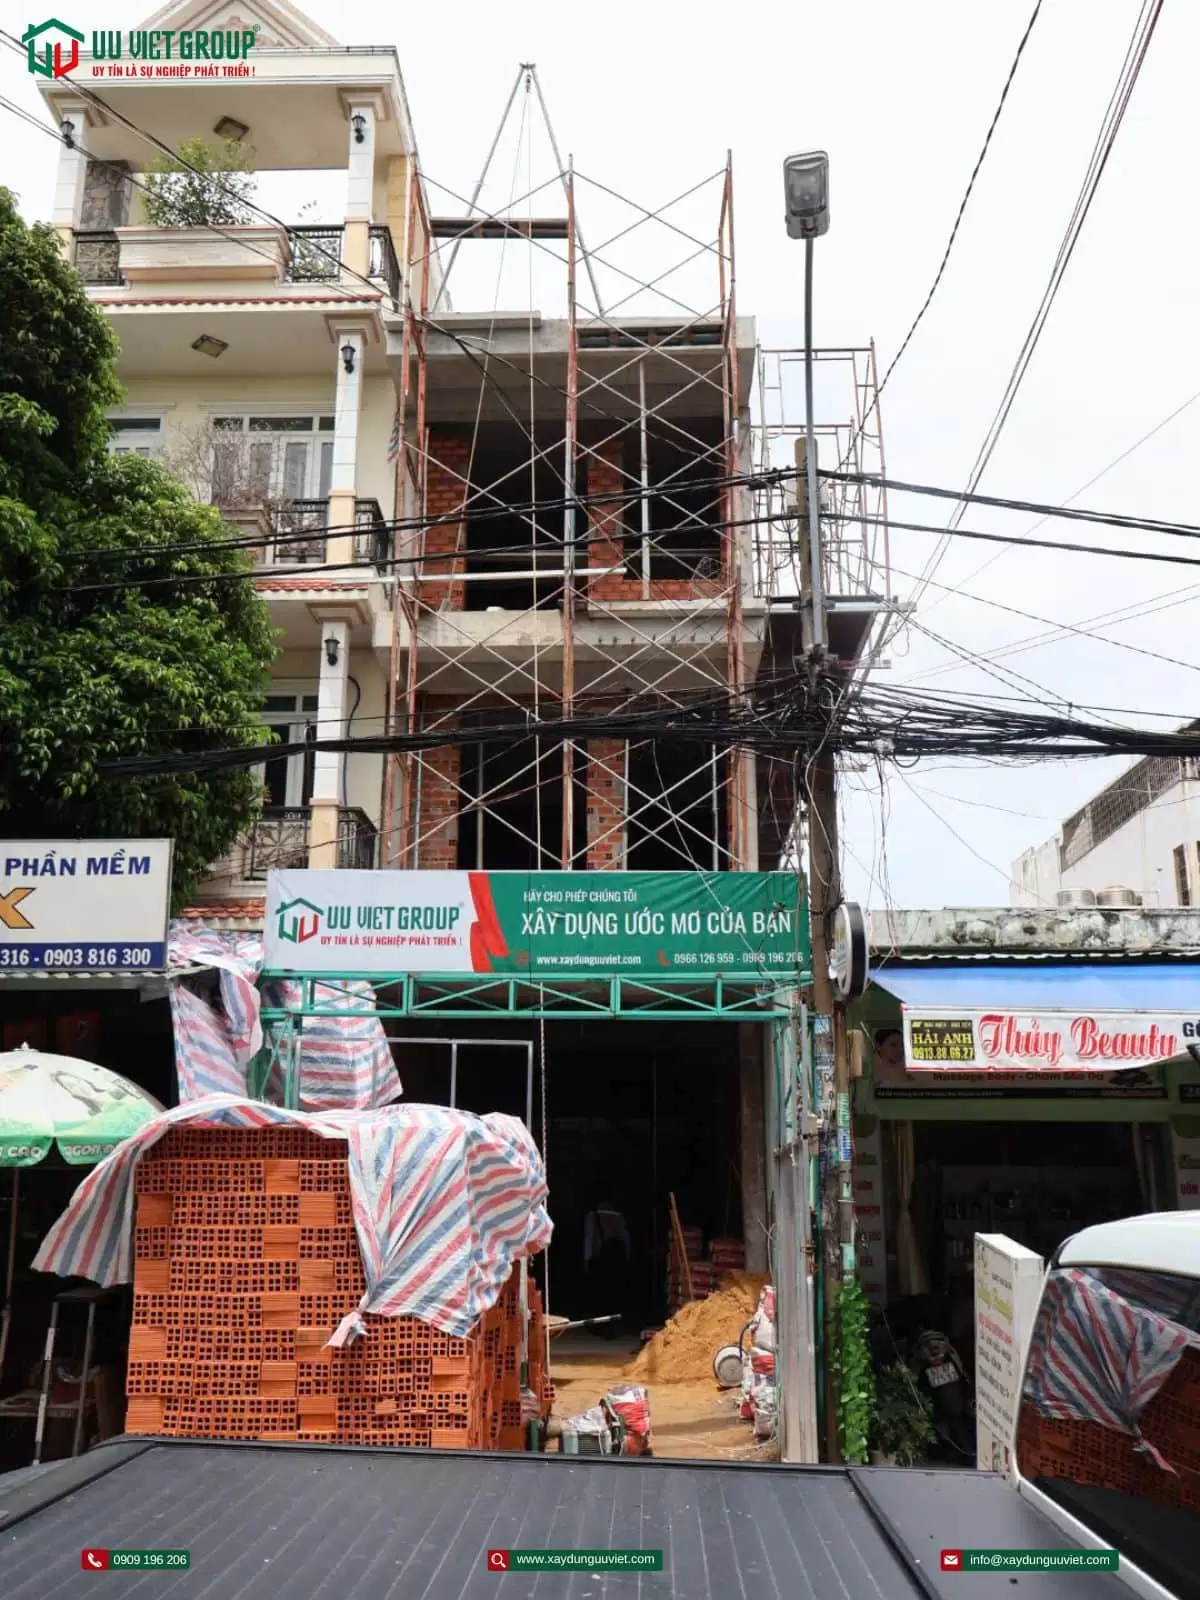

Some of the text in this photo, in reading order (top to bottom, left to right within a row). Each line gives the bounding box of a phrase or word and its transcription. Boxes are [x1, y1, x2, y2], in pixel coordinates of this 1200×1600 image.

[5, 848, 151, 876] PHẦN MỀM
[543, 890, 563, 902] CHO
[564, 888, 588, 902] PHÉP
[589, 888, 621, 902] CHÚNG
[398, 906, 460, 931] GROUP
[521, 905, 791, 939] XÂY DỰNG ƯỚC MƠ CỦA BẠN
[320, 935, 332, 945] UY
[0, 950, 29, 965] 316
[44, 949, 82, 965] 0903
[87, 949, 116, 965] 816
[122, 948, 151, 965] 300
[536, 954, 642, 966] www.xaydunguuviet.com
[674, 953, 697, 964] 0966
[699, 953, 714, 964] 126
[768, 952, 784, 964] 196
[912, 1028, 972, 1044] HẢI ANH
[978, 1014, 1064, 1066] Thủy
